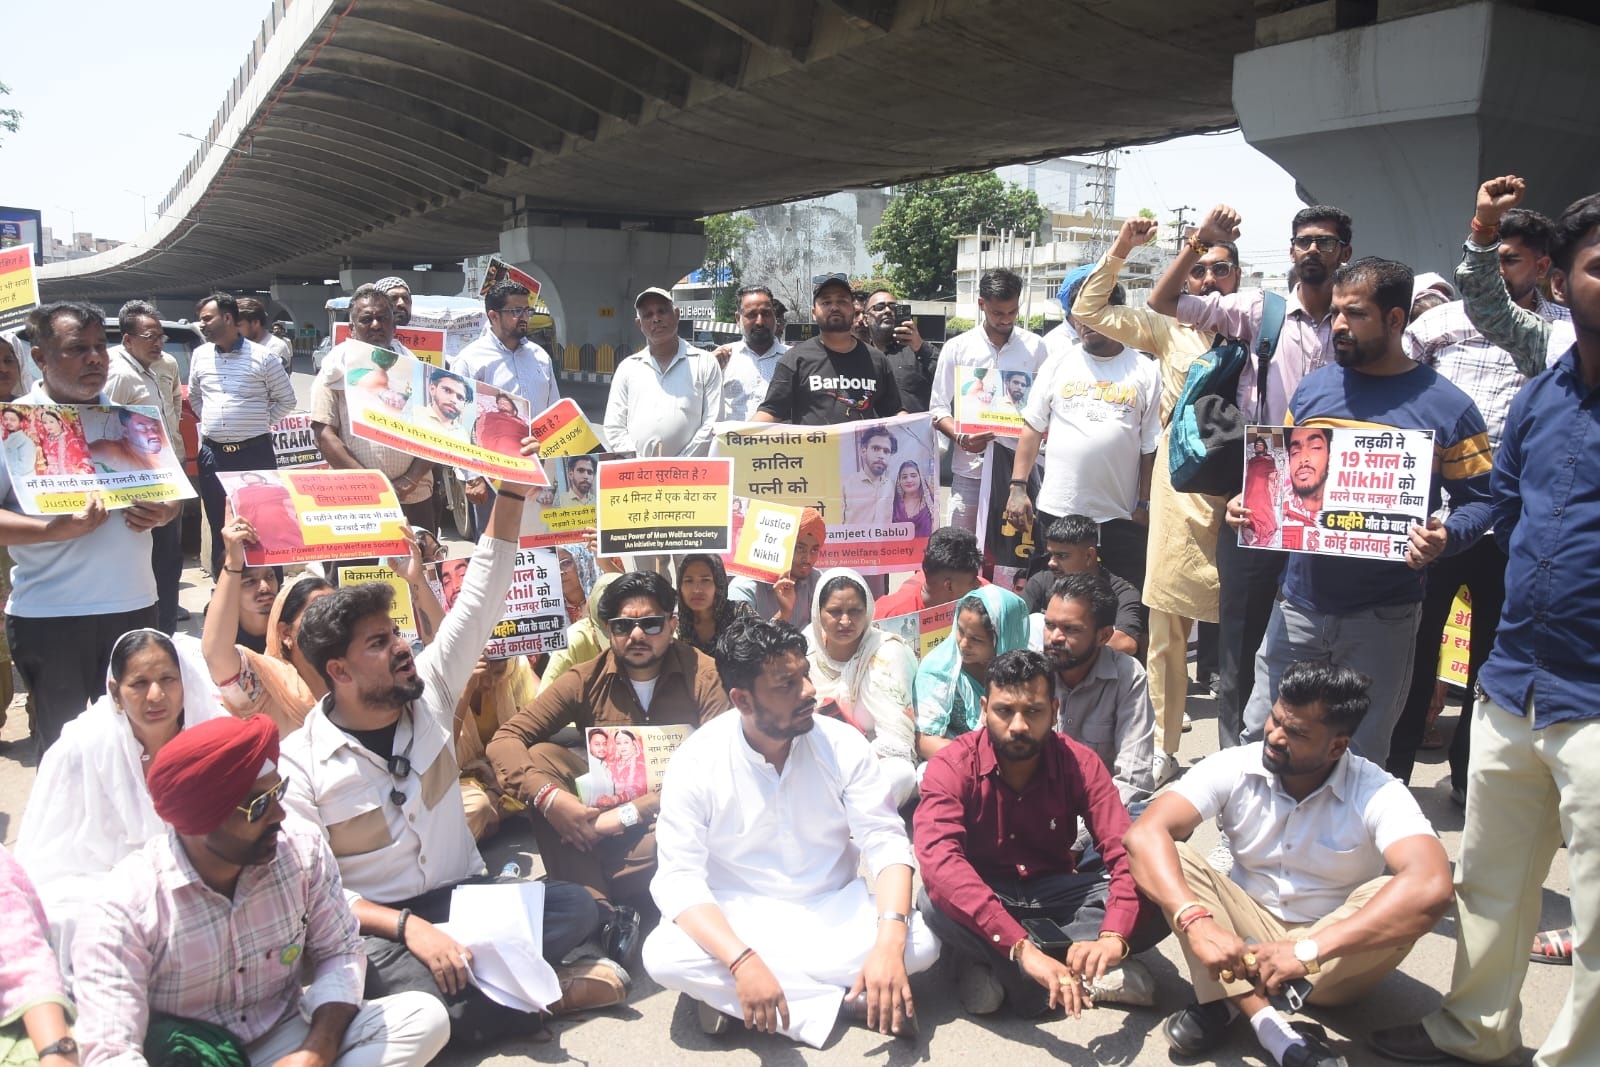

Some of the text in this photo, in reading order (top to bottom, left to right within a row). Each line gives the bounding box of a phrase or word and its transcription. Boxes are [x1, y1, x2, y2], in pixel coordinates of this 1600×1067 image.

[394, 333, 411, 344] क्षित
[809, 374, 876, 391] Barbour
[532, 423, 549, 439] क्षित
[566, 427, 583, 441] 90%
[272, 430, 314, 450] KRAM
[1354, 432, 1406, 452] लड़की ने
[1340, 451, 1416, 470] 19 साल के
[618, 466, 708, 482] क्या बेटा सुरक्षित है ?
[1337, 470, 1416, 490] Nikhil को
[57, 477, 78, 488] शादी
[749, 477, 808, 495] पत्नी को
[43, 499, 86, 509] Justice
[610, 495, 620, 506] हर
[622, 494, 629, 503] 4
[631, 491, 652, 503] मिनट
[664, 492, 681, 504] एक
[683, 489, 699, 502] बेटा
[702, 492, 718, 502] कर
[1330, 489, 1424, 509] मरने पर मजबूर किया
[305, 515, 312, 523] 6
[628, 509, 696, 524] रहा है आत्महत्या
[759, 516, 791, 530] Justice
[1326, 514, 1336, 528] 6
[1337, 511, 1364, 531] महीने
[1365, 514, 1380, 531] मौत
[1381, 516, 1389, 530] के
[1391, 520, 1406, 533] बाद
[628, 532, 645, 542] Power
[646, 531, 653, 540] of
[668, 531, 693, 539] Welfare
[694, 529, 718, 540] Society
[764, 533, 778, 544] for
[875, 527, 908, 538] Bablu)
[316, 545, 325, 553] of
[820, 547, 914, 558] Men Welfare Society
[1325, 532, 1347, 554] कोई
[1349, 533, 1391, 558] कार्रवाई
[526, 551, 535, 564] ने
[753, 548, 780, 563] Nikhil
[345, 569, 393, 580] बिक्रमजीत
[536, 566, 547, 580] के
[536, 583, 550, 596] को
[515, 601, 540, 614] मजबूर
[541, 598, 560, 609] किया
[494, 617, 559, 637] महीने मौत के बाद भी
[508, 635, 542, 653] कार्रवाई
[544, 631, 565, 649] नहीं!
